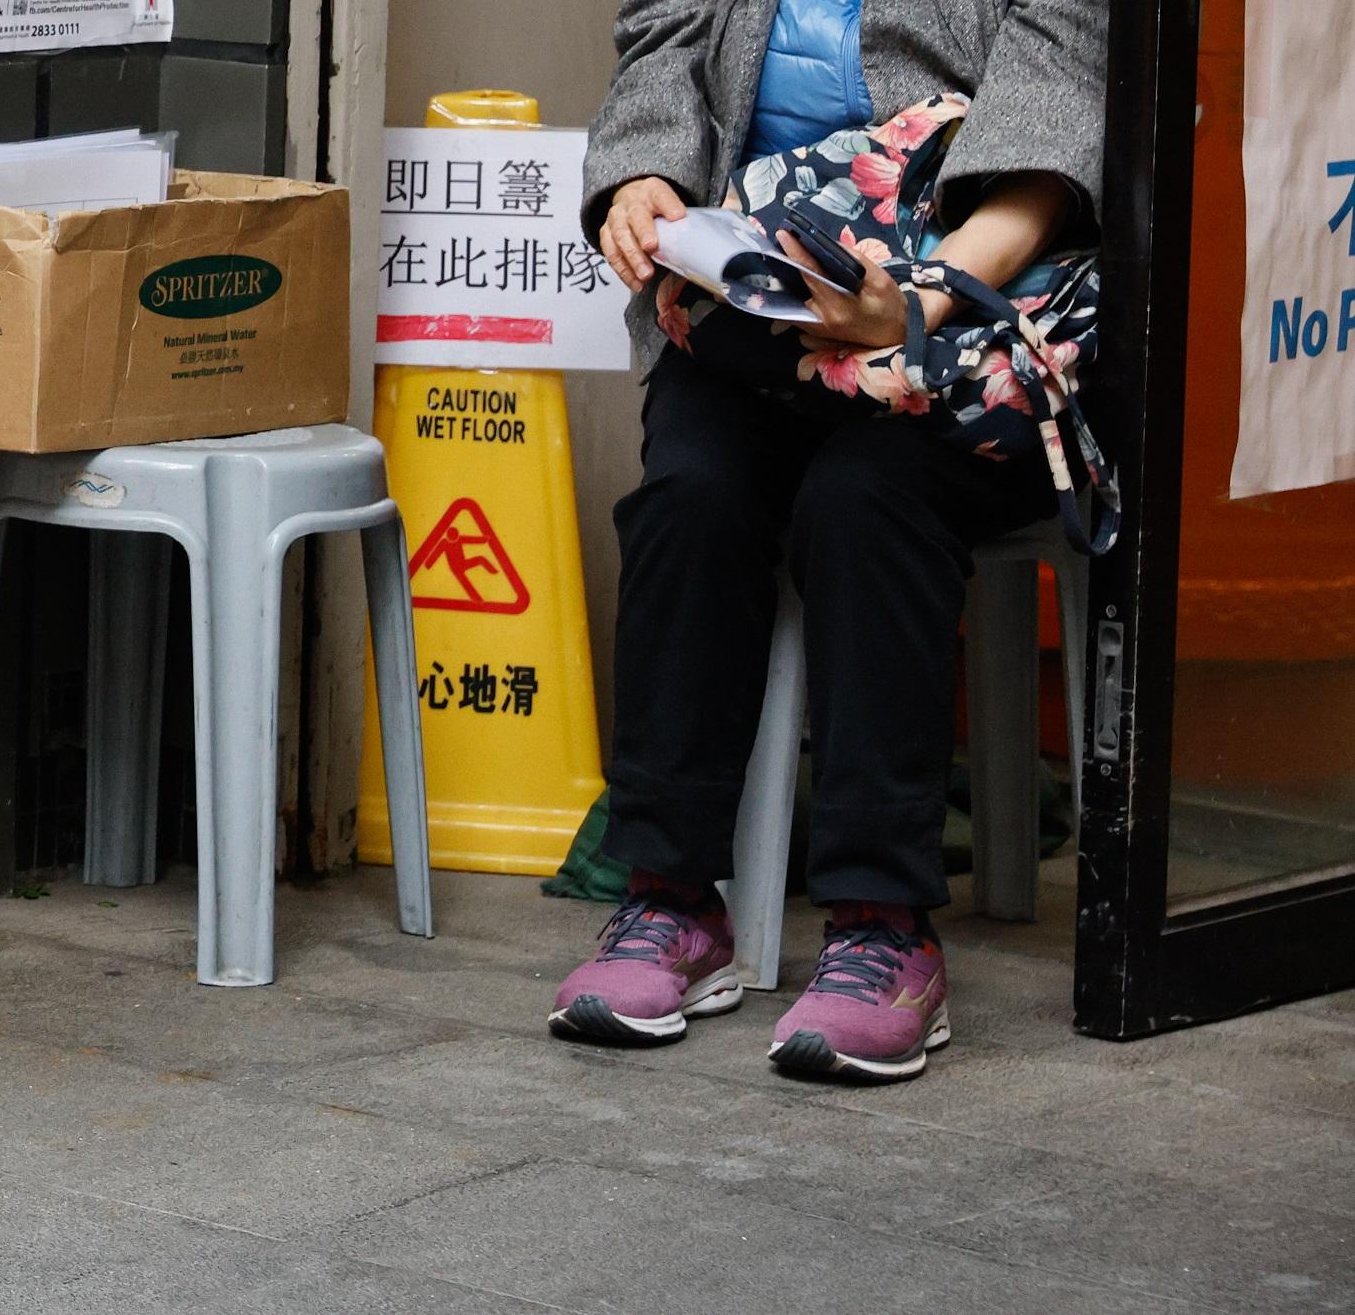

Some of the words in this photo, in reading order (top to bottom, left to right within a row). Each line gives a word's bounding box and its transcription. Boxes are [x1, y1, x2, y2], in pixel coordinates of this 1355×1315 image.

[31, 24, 56, 37] 2833
[59, 23, 80, 36] 0111
[386, 159, 551, 215] 即日籌
[379, 235, 610, 294] 在此排隊
[151, 270, 262, 307] SPRITZER
[164, 334, 195, 347] Natural
[197, 331, 227, 344] Mineral
[230, 329, 257, 341] Water
[1269, 297, 1328, 363] No
[427, 387, 517, 414] CAUTION
[417, 415, 457, 440] WET
[461, 417, 525, 444] FLOOR
